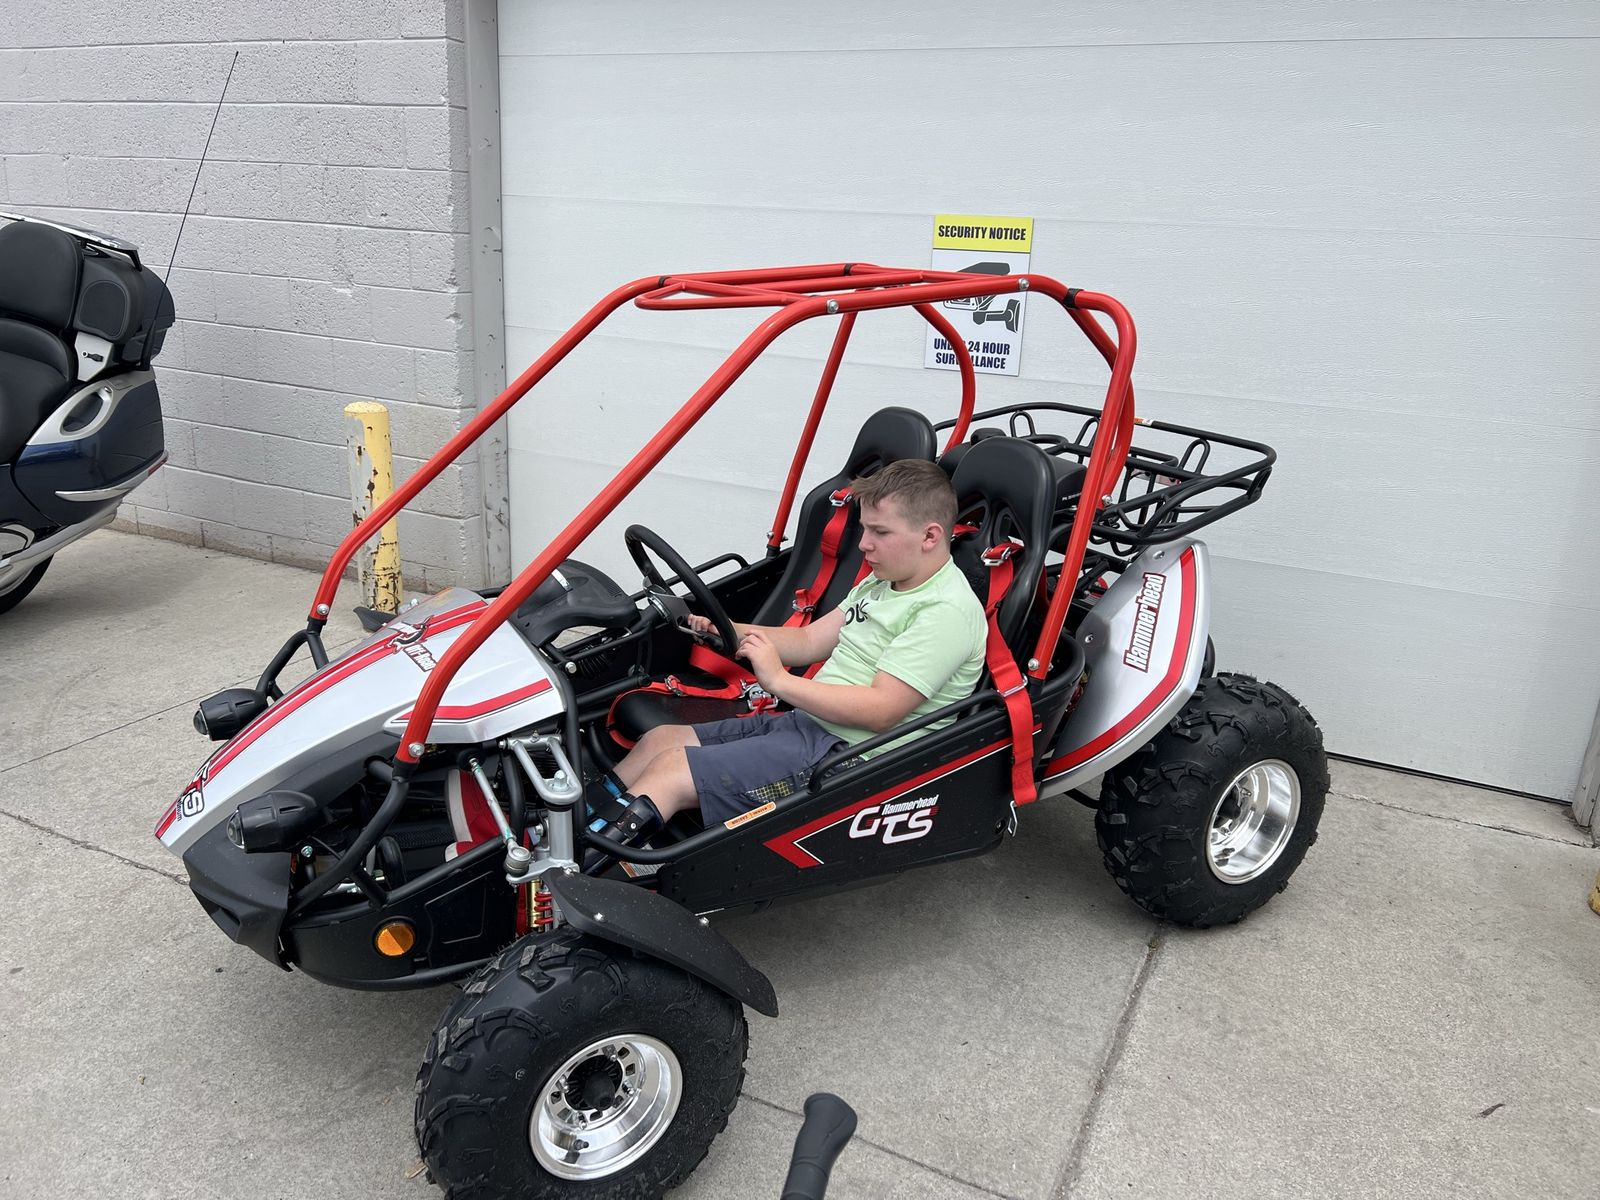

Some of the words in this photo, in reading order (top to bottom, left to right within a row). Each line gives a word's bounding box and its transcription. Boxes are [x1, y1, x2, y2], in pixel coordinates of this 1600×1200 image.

[938, 225, 988, 239] SECURITY
[989, 227, 1026, 240] NOTICE
[968, 341, 980, 353] 24
[982, 343, 1010, 356] HOUR
[1125, 573, 1166, 670] Hammerhead
[881, 794, 940, 815] Hammerhead
[849, 806, 933, 845] GTS
